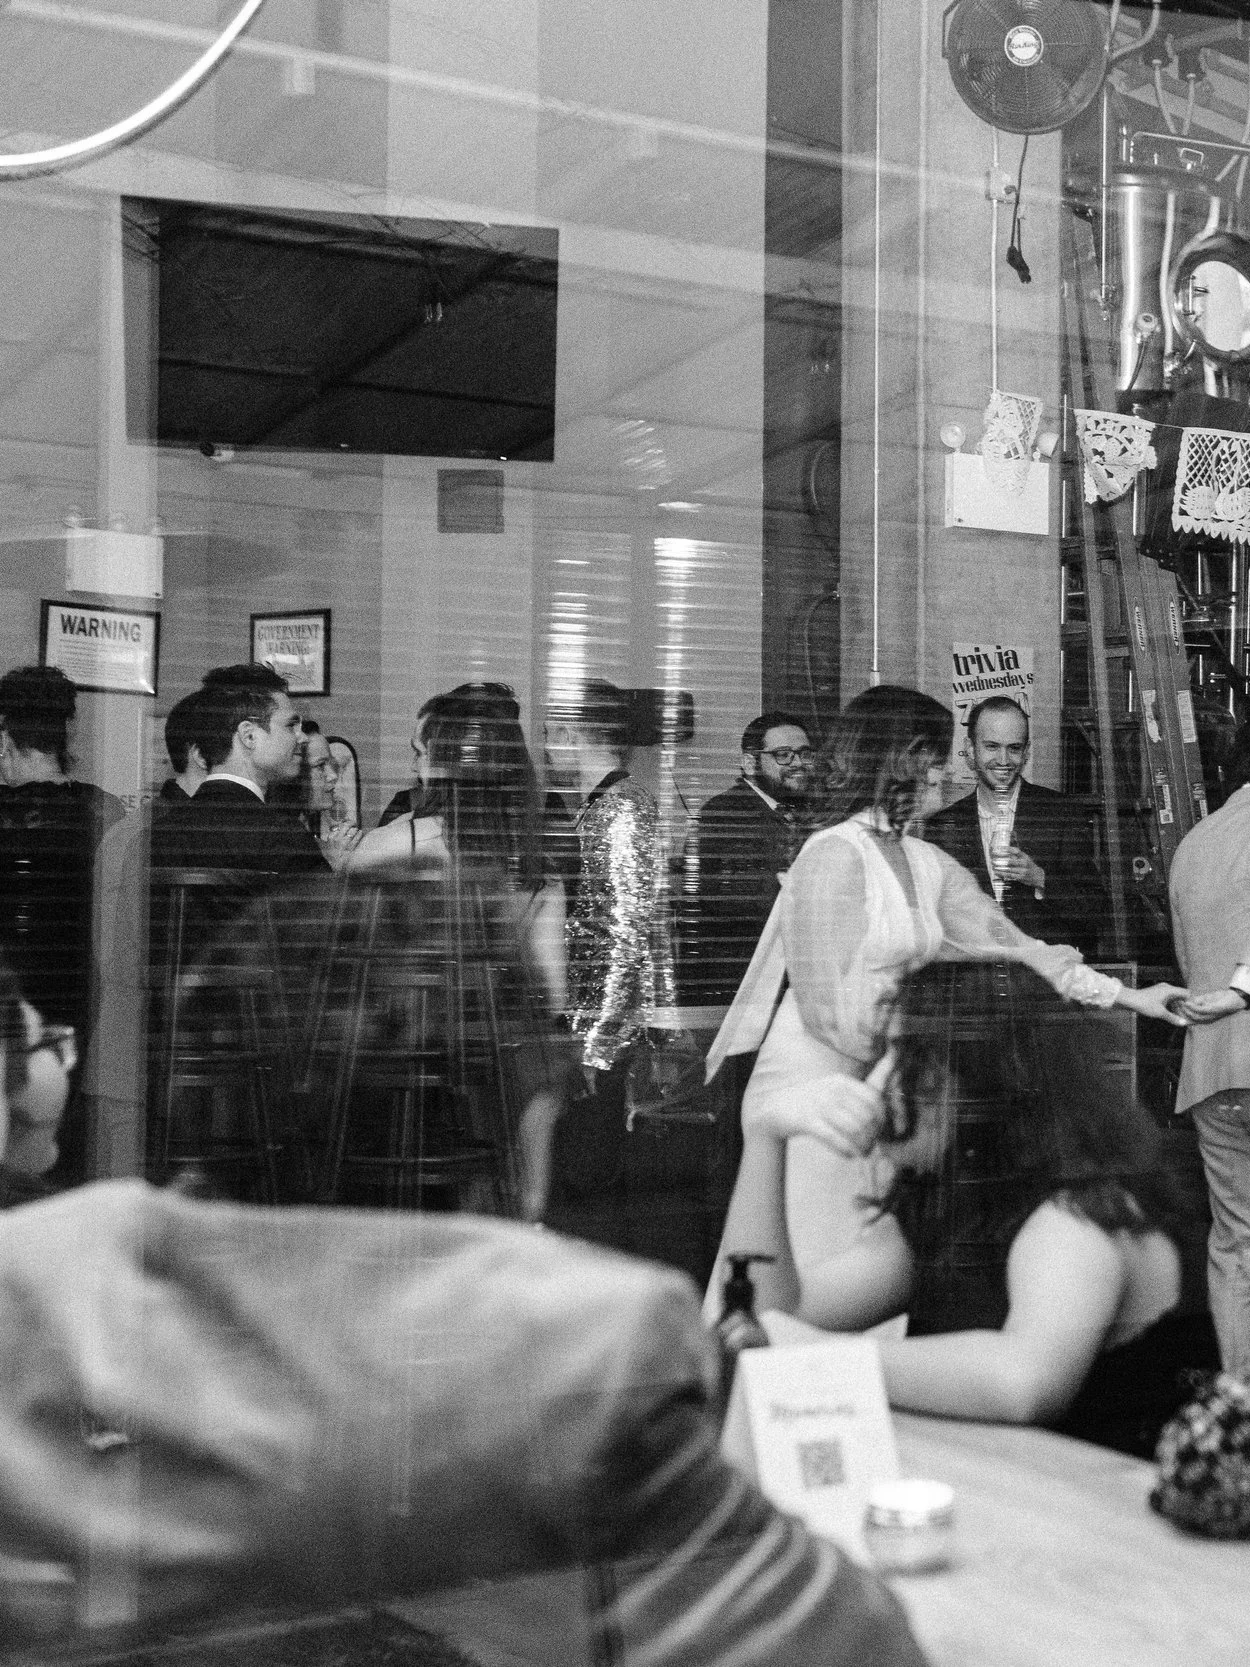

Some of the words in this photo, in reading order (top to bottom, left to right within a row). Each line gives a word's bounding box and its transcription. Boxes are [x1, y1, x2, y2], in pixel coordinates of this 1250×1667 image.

[60, 613, 141, 643] WARNING
[257, 624, 320, 641] GOVERNMENT
[952, 645, 1020, 676] trivia
[952, 672, 1034, 693] wednesdays
